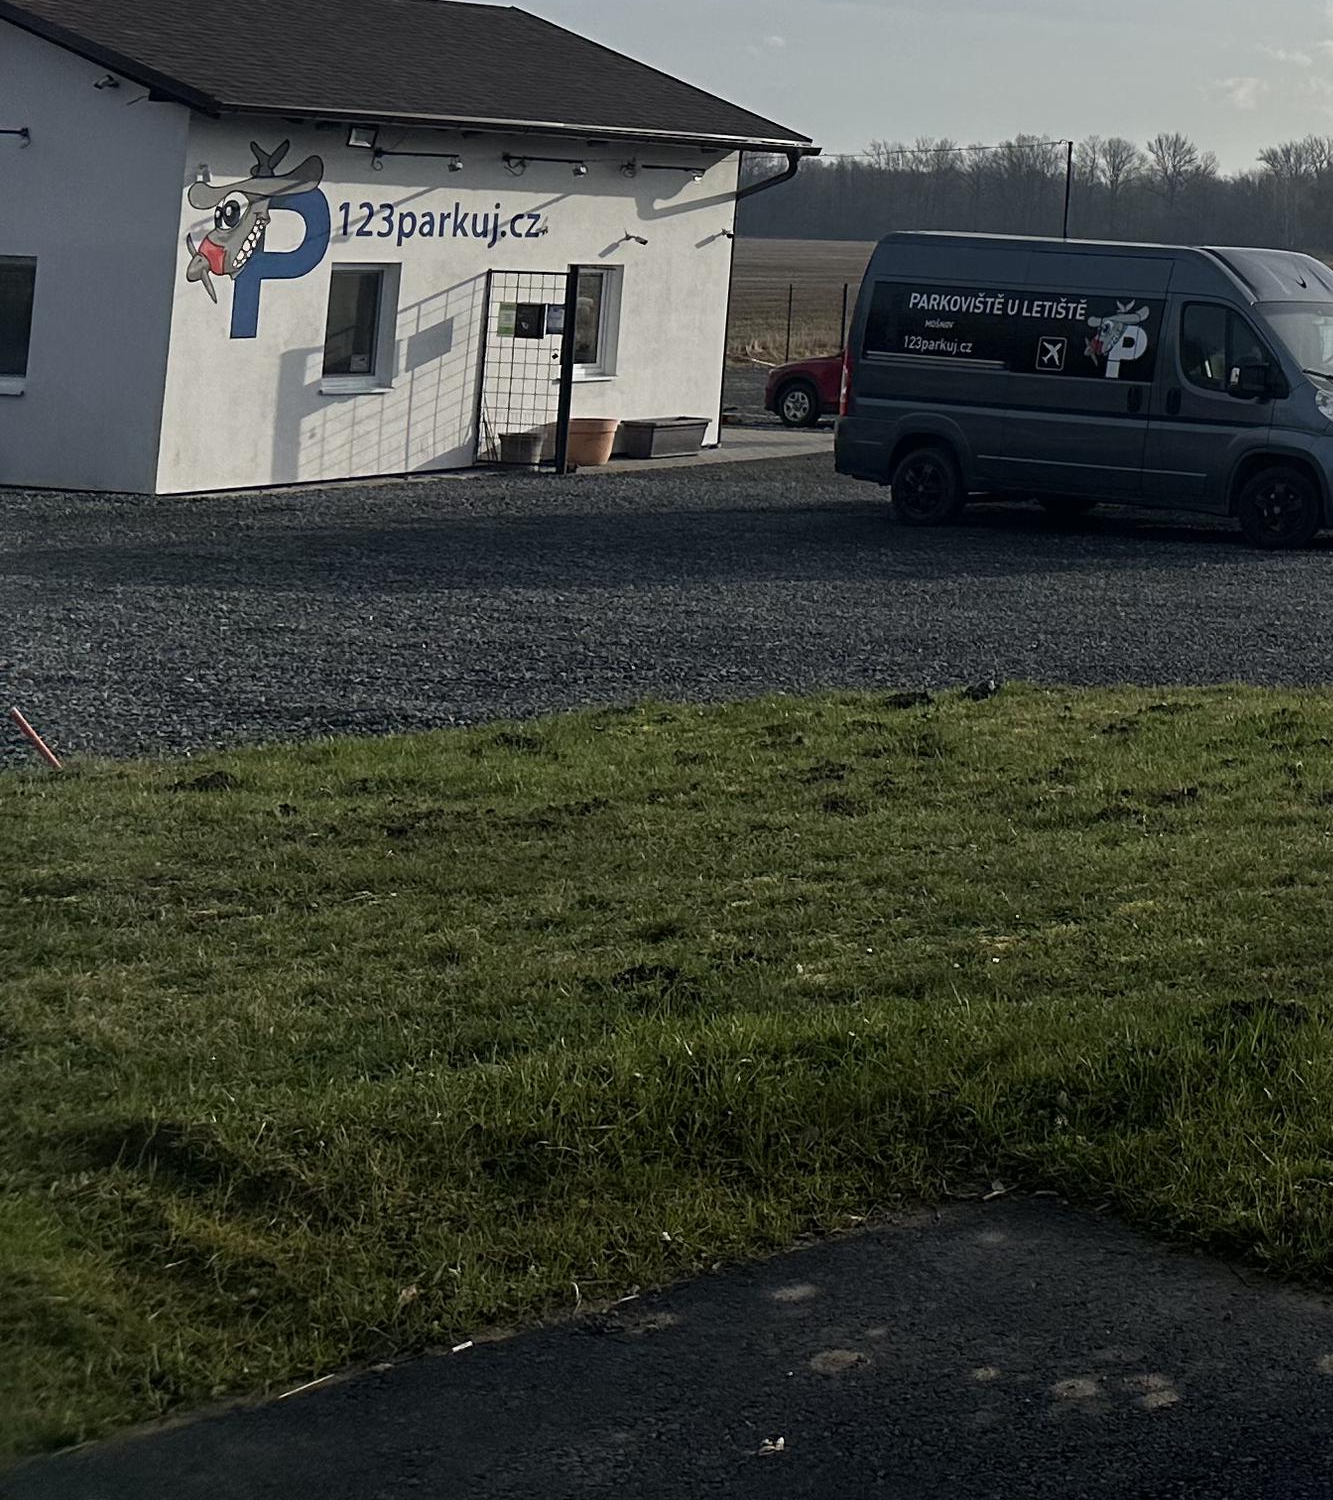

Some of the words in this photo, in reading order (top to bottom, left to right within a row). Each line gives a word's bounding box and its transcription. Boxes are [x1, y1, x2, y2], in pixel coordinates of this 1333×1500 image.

[338, 201, 541, 249] 123parkuj.cz
[908, 292, 1004, 315] PARKOVIŠTĚ
[1007, 299, 1019, 315] U
[1022, 297, 1087, 320] LETIŠTĚ
[903, 335, 973, 356] 123parkuj.cz
